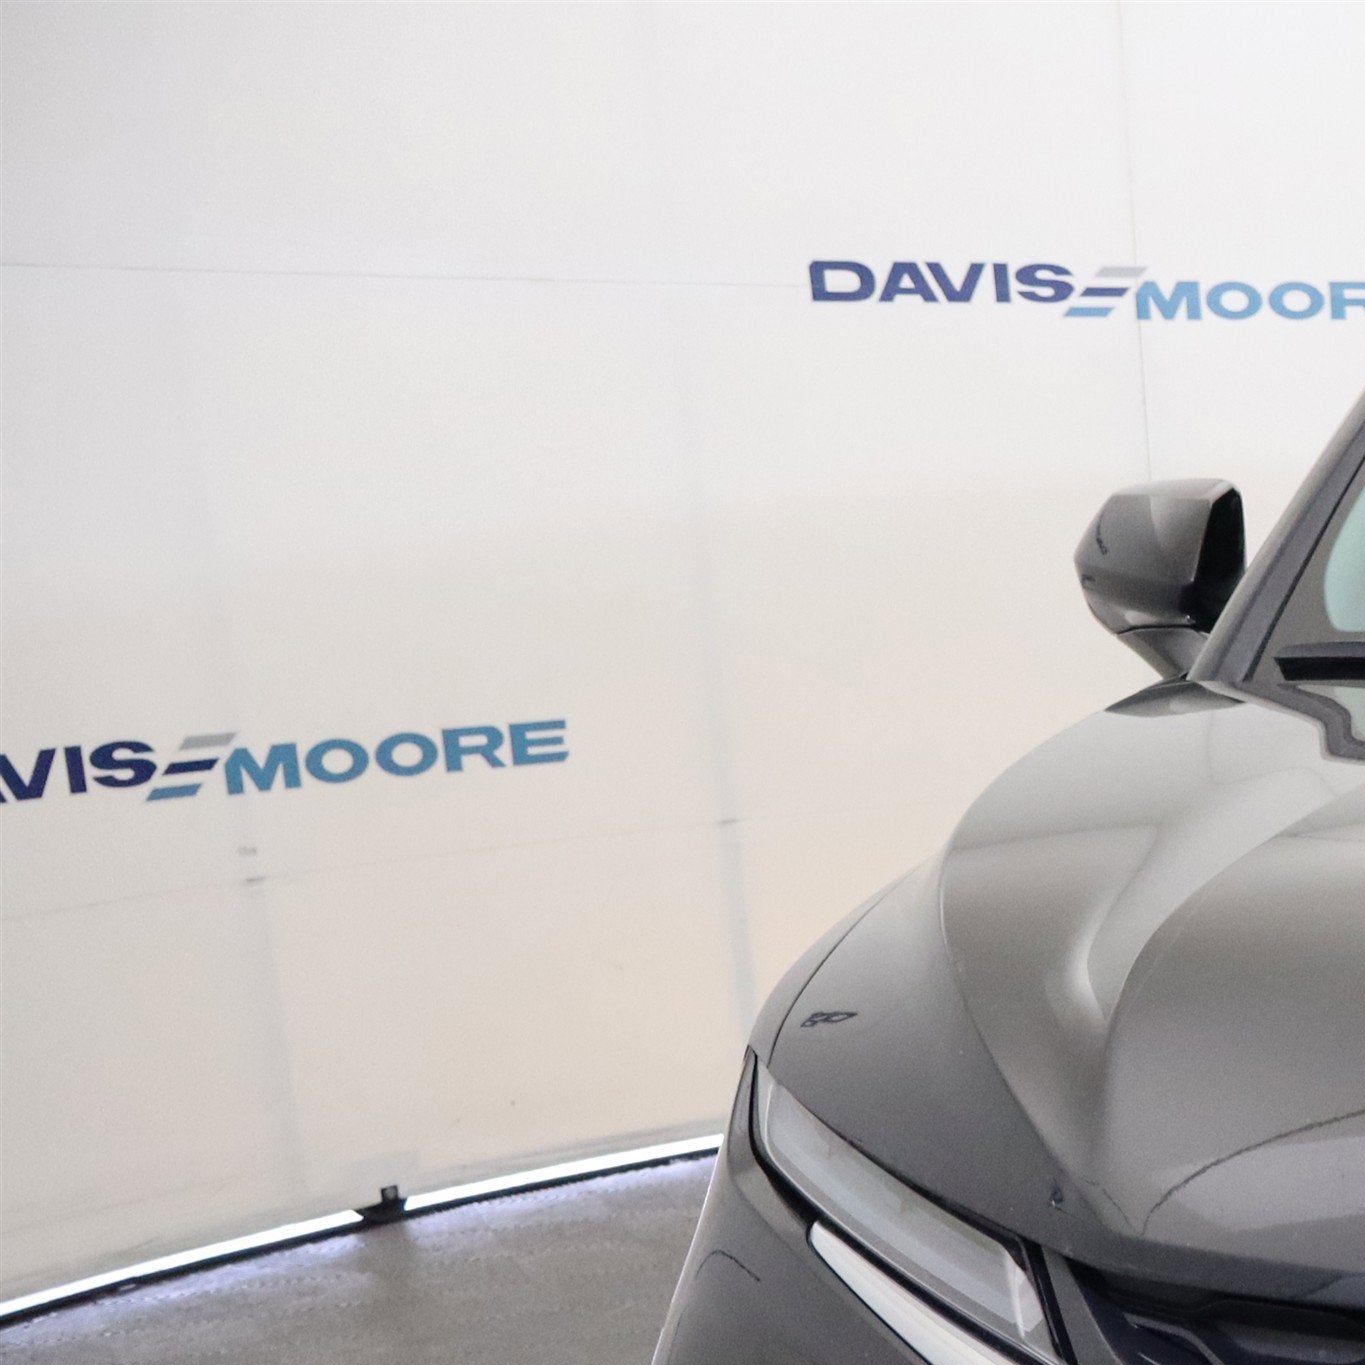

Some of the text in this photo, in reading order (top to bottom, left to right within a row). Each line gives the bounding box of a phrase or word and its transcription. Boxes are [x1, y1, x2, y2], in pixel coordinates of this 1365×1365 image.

[809, 260, 1074, 303] DAVIS
[0, 719, 569, 801] VIS MOORE
